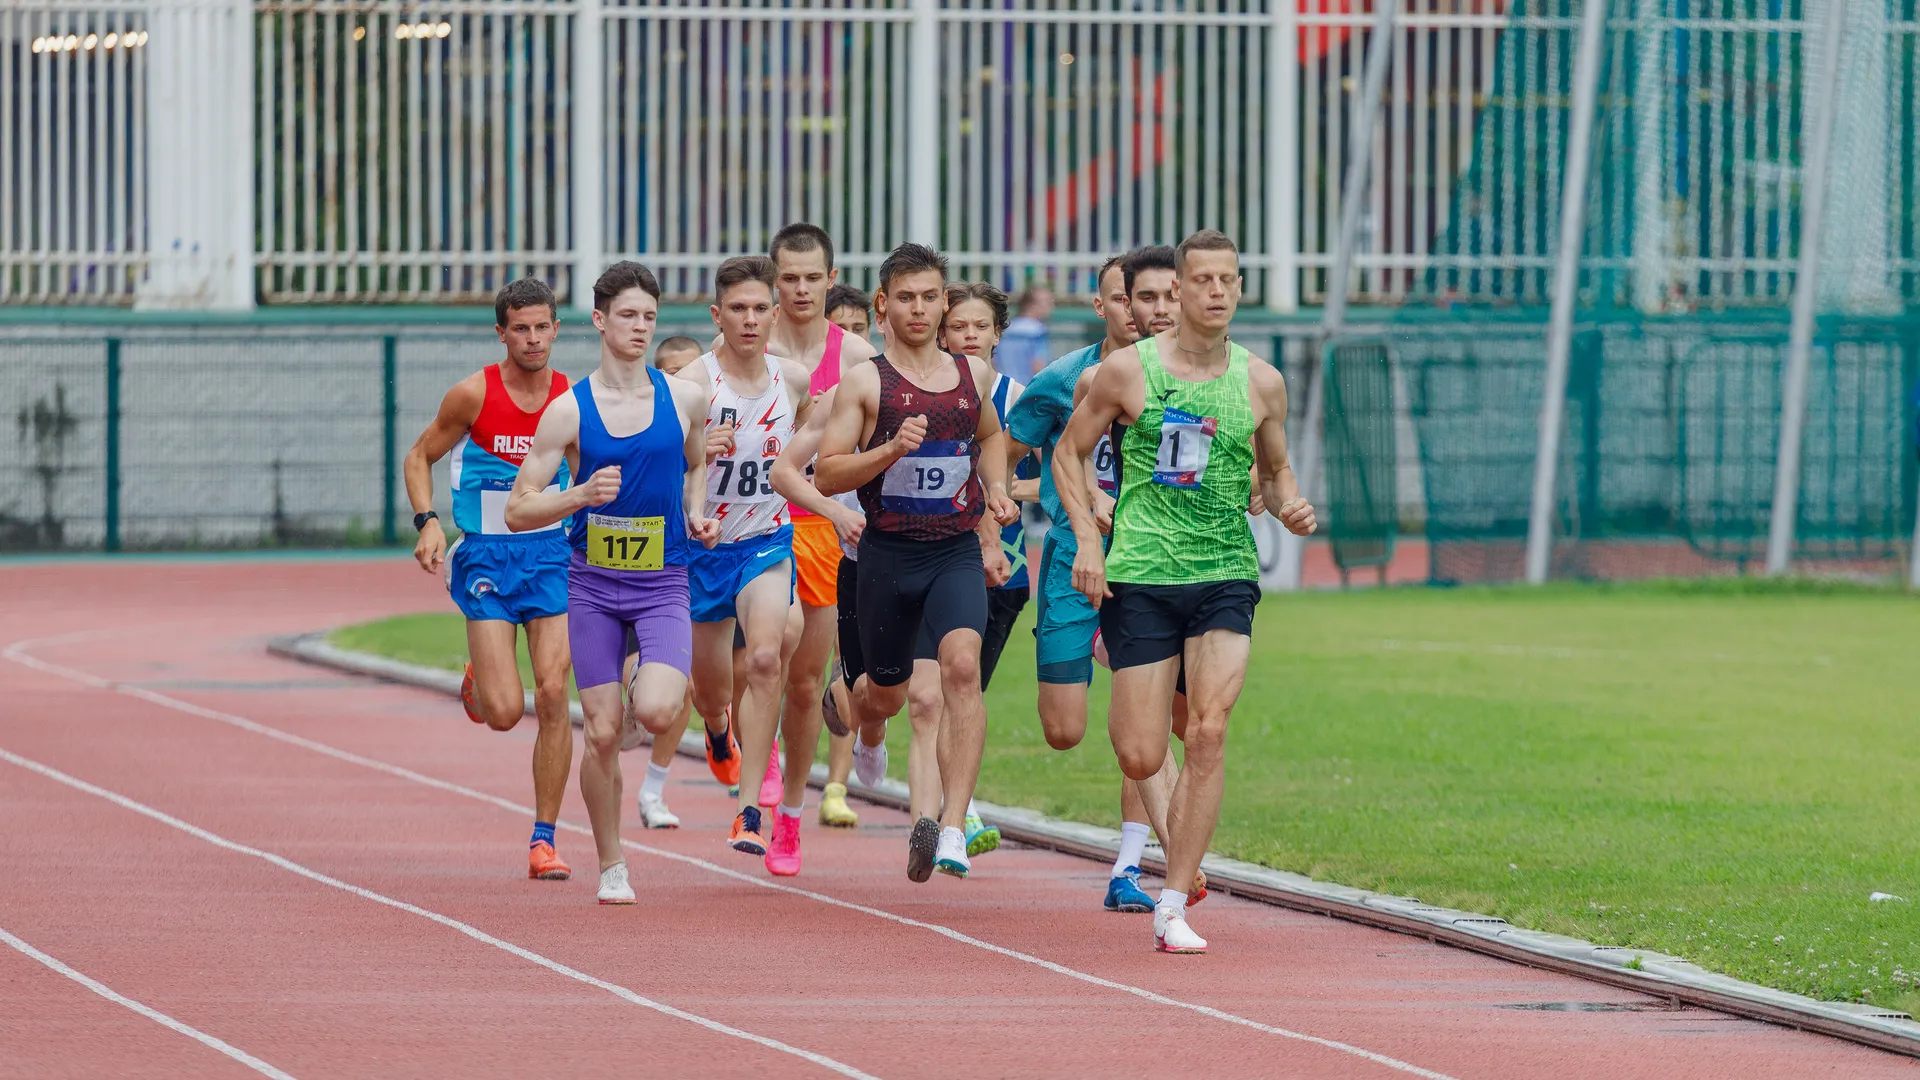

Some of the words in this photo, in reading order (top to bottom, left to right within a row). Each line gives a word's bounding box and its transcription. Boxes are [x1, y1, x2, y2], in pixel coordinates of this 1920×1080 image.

[494, 434, 535, 454] RUS
[716, 460, 776, 496] 783
[915, 467, 945, 490] 19
[602, 535, 650, 560] 117
